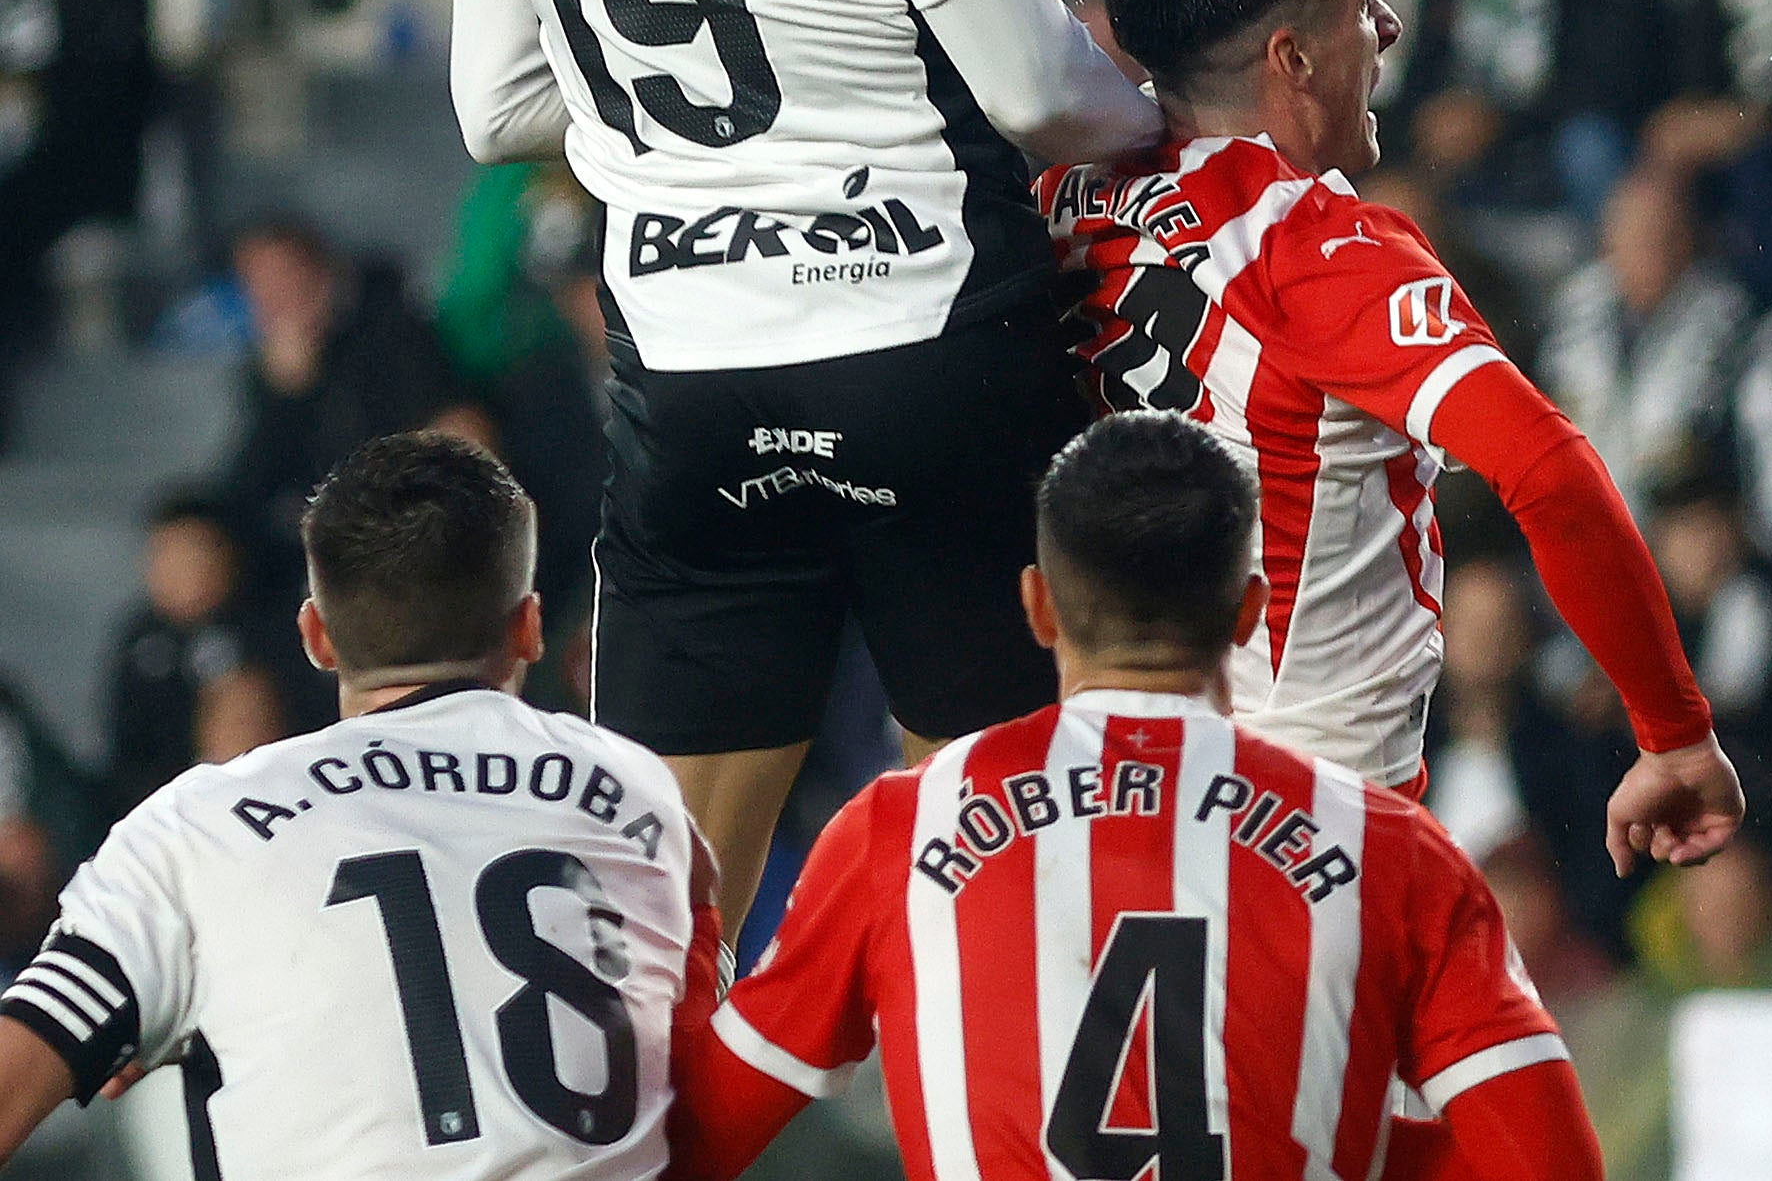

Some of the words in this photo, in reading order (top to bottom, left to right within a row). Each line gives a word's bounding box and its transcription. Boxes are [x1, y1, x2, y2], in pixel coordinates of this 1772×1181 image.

[791, 256, 891, 285] Energía
[915, 760, 1163, 898] RÓBER
[1195, 774, 1357, 901] PIER
[322, 848, 641, 1147] 18
[1042, 911, 1231, 1181] 4
